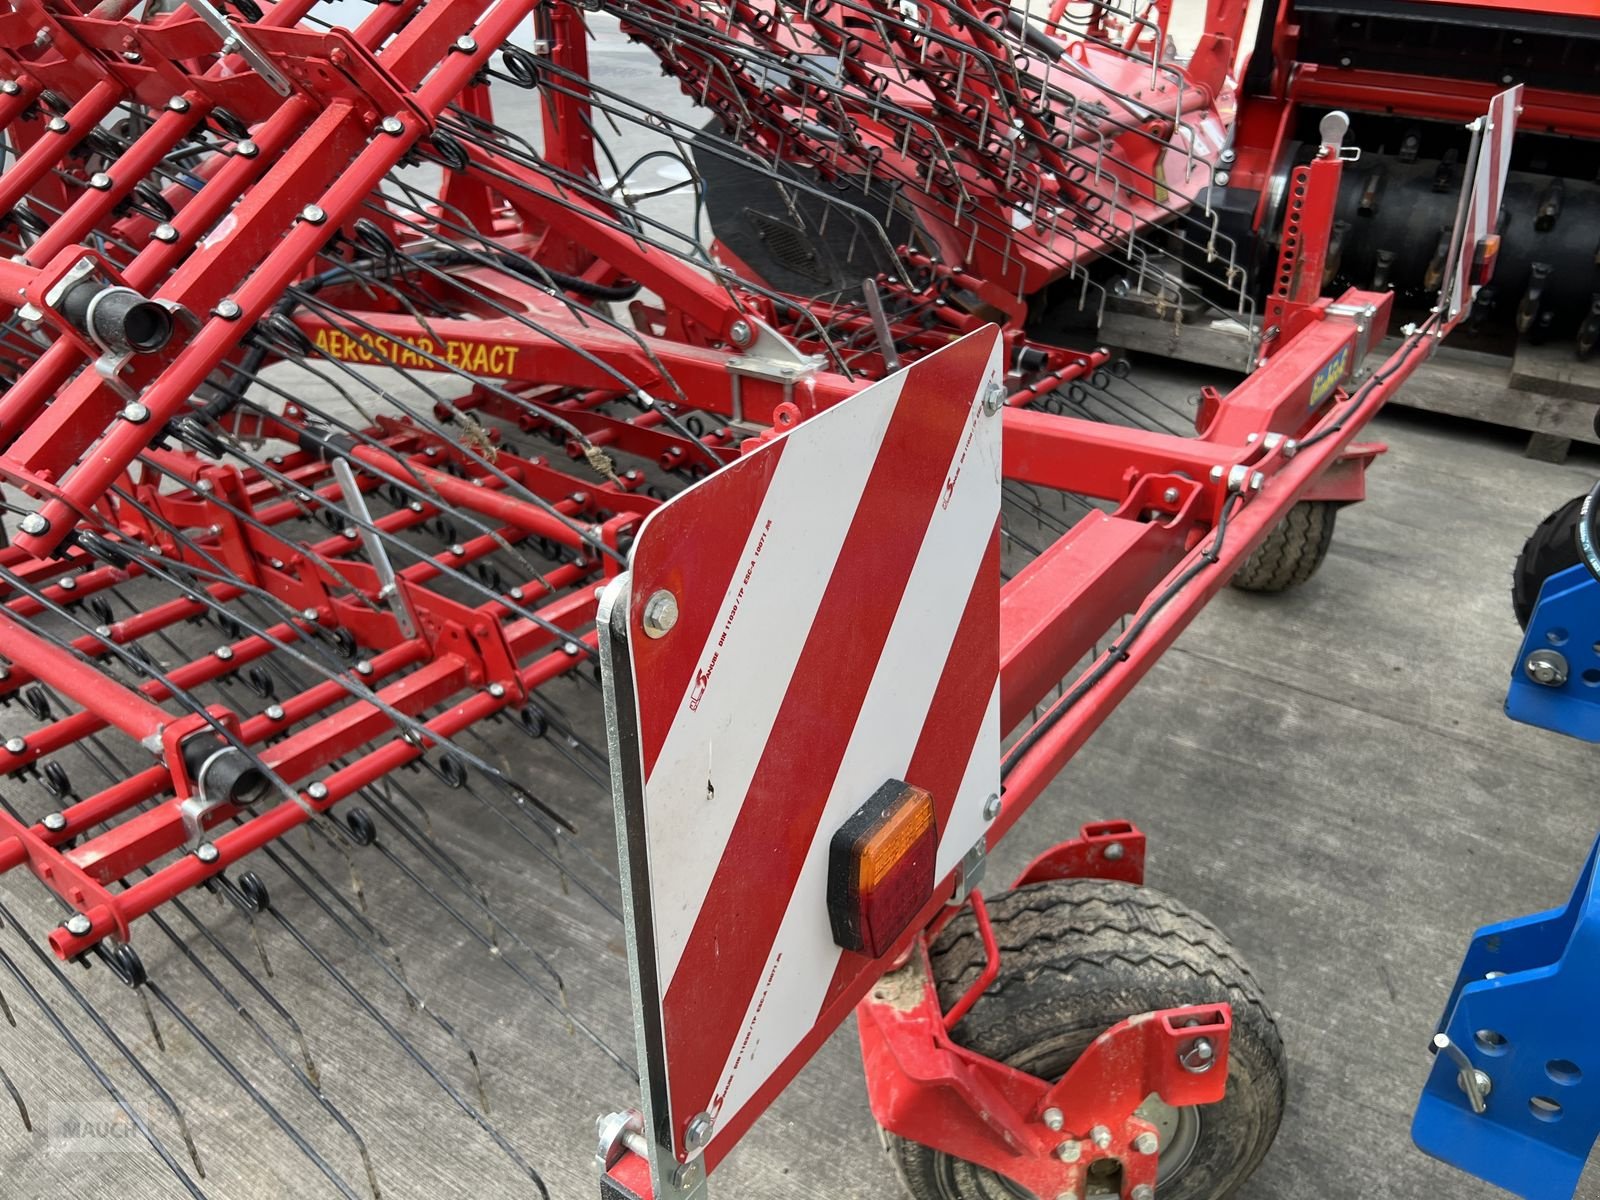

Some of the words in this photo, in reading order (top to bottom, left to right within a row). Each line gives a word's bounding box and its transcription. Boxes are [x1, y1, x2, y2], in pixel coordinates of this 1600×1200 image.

[718, 631, 727, 647] DIN
[725, 605, 738, 630] 11030
[738, 587, 744, 599] TP
[743, 560, 756, 585] ESC-A
[754, 533, 767, 557] 10071
